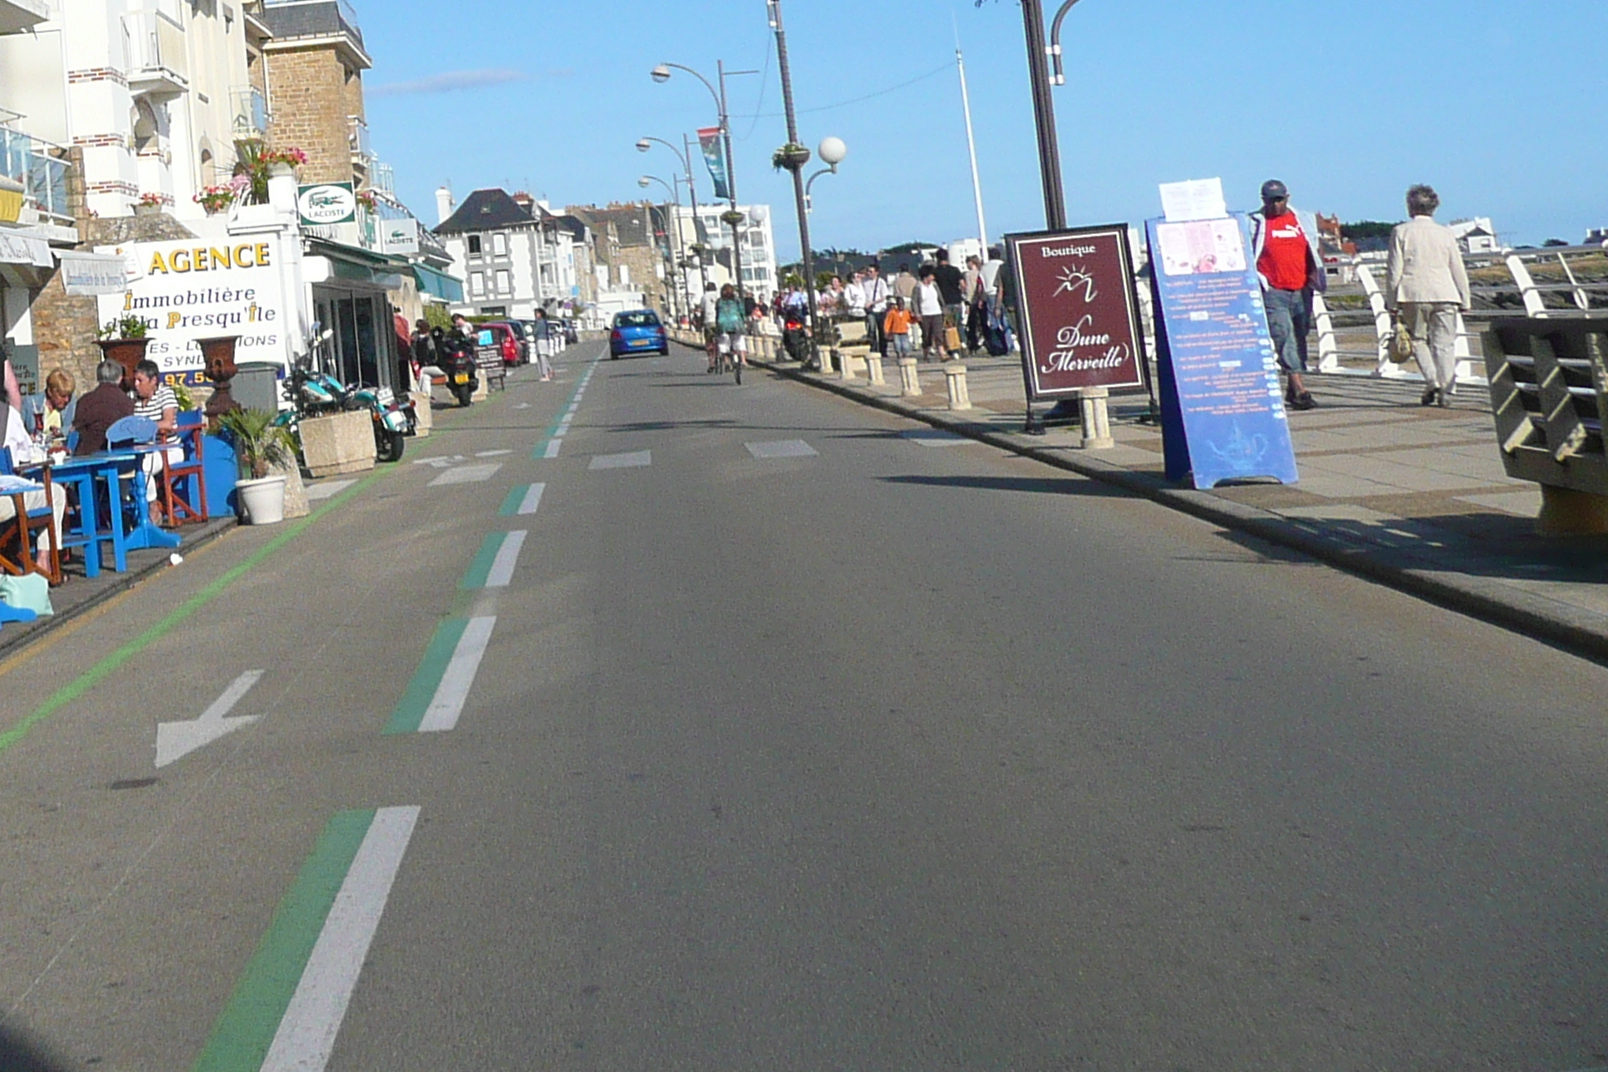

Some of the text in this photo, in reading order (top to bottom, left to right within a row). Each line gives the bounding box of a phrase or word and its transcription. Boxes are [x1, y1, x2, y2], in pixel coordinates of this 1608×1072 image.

[308, 209, 345, 219] LACOSTE
[148, 242, 271, 276] AGENCE
[1041, 244, 1096, 258] Boutique
[1056, 314, 1110, 349] Dune
[1041, 342, 1130, 374] Merveille
